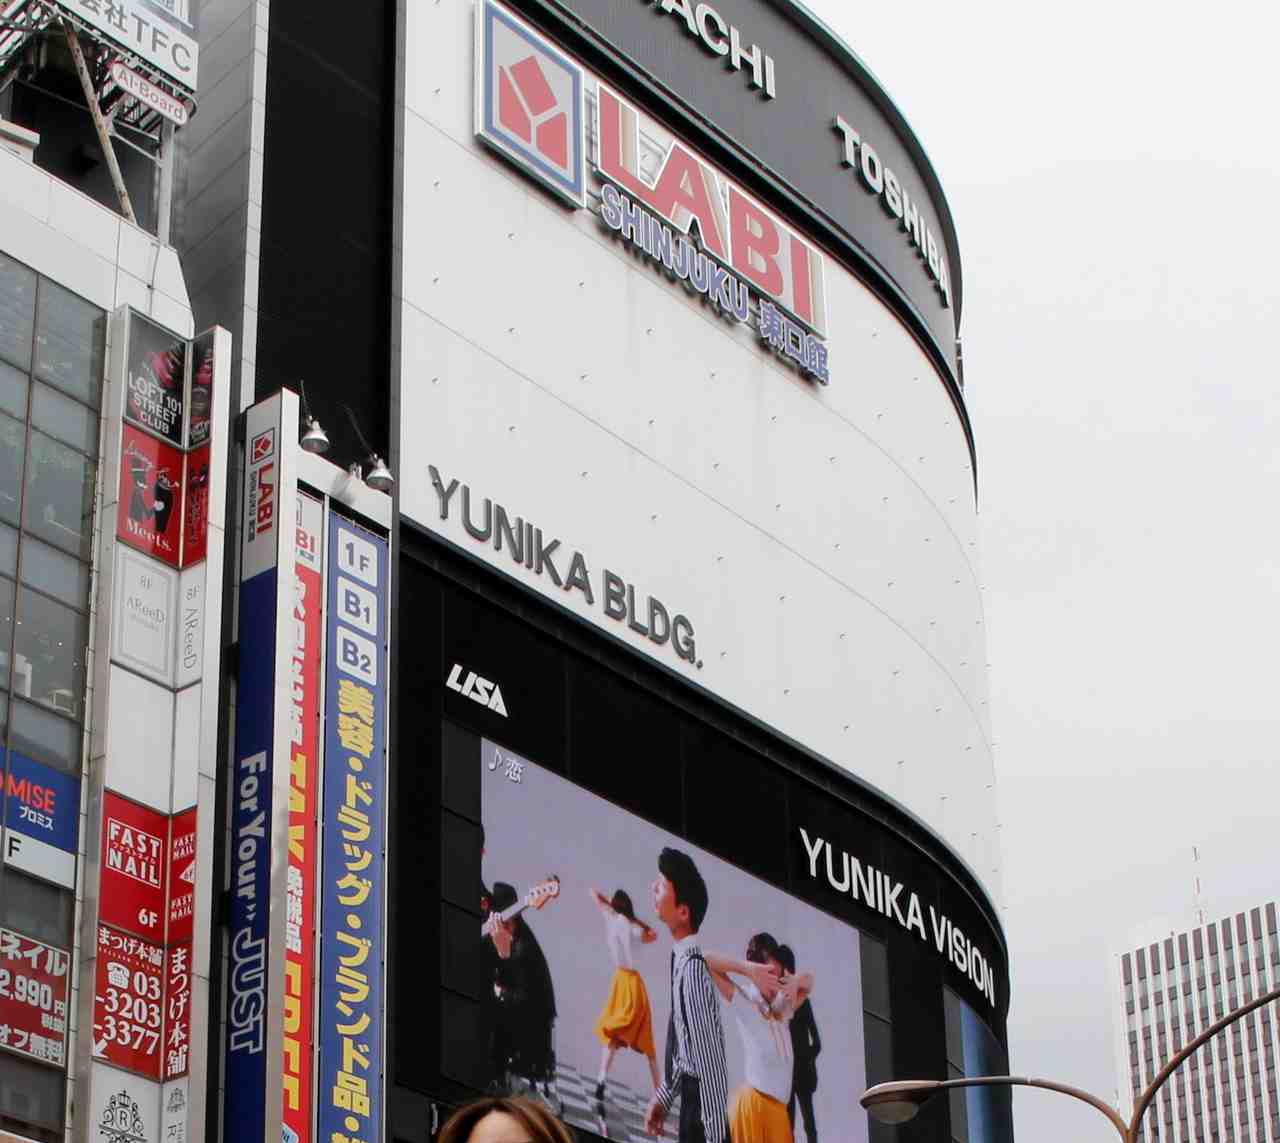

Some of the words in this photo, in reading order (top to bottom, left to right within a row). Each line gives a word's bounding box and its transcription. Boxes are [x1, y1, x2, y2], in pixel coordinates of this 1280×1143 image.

[650, 0, 777, 99] ACHI
[597, 82, 825, 341] LABI
[832, 114, 950, 308] TOSHIBA
[599, 183, 750, 325] SHINJUKU
[759, 299, 828, 385] 東口館
[128, 371, 167, 403] LOFT
[133, 391, 178, 425] STREET
[139, 409, 170, 435] CLUB
[256, 463, 274, 534] LABI
[345, 541, 370, 573] 1F
[427, 464, 594, 607] YUNIKA
[602, 567, 703, 670] BLDG.
[344, 588, 371, 624] B1
[342, 638, 372, 673] B2
[240, 751, 266, 812] For
[19, 806, 53, 830] プロミス
[110, 823, 160, 855] FAST
[237, 811, 265, 900] Your
[108, 847, 160, 886] NAIL
[139, 908, 159, 929] 6F
[799, 827, 927, 940] YUNIKA
[928, 912, 997, 1008] VISION
[0, 934, 67, 976] ネイル
[98, 927, 163, 967] まつげ本舗
[134, 971, 162, 998] 03
[167, 947, 189, 1076] まつげ本舗
